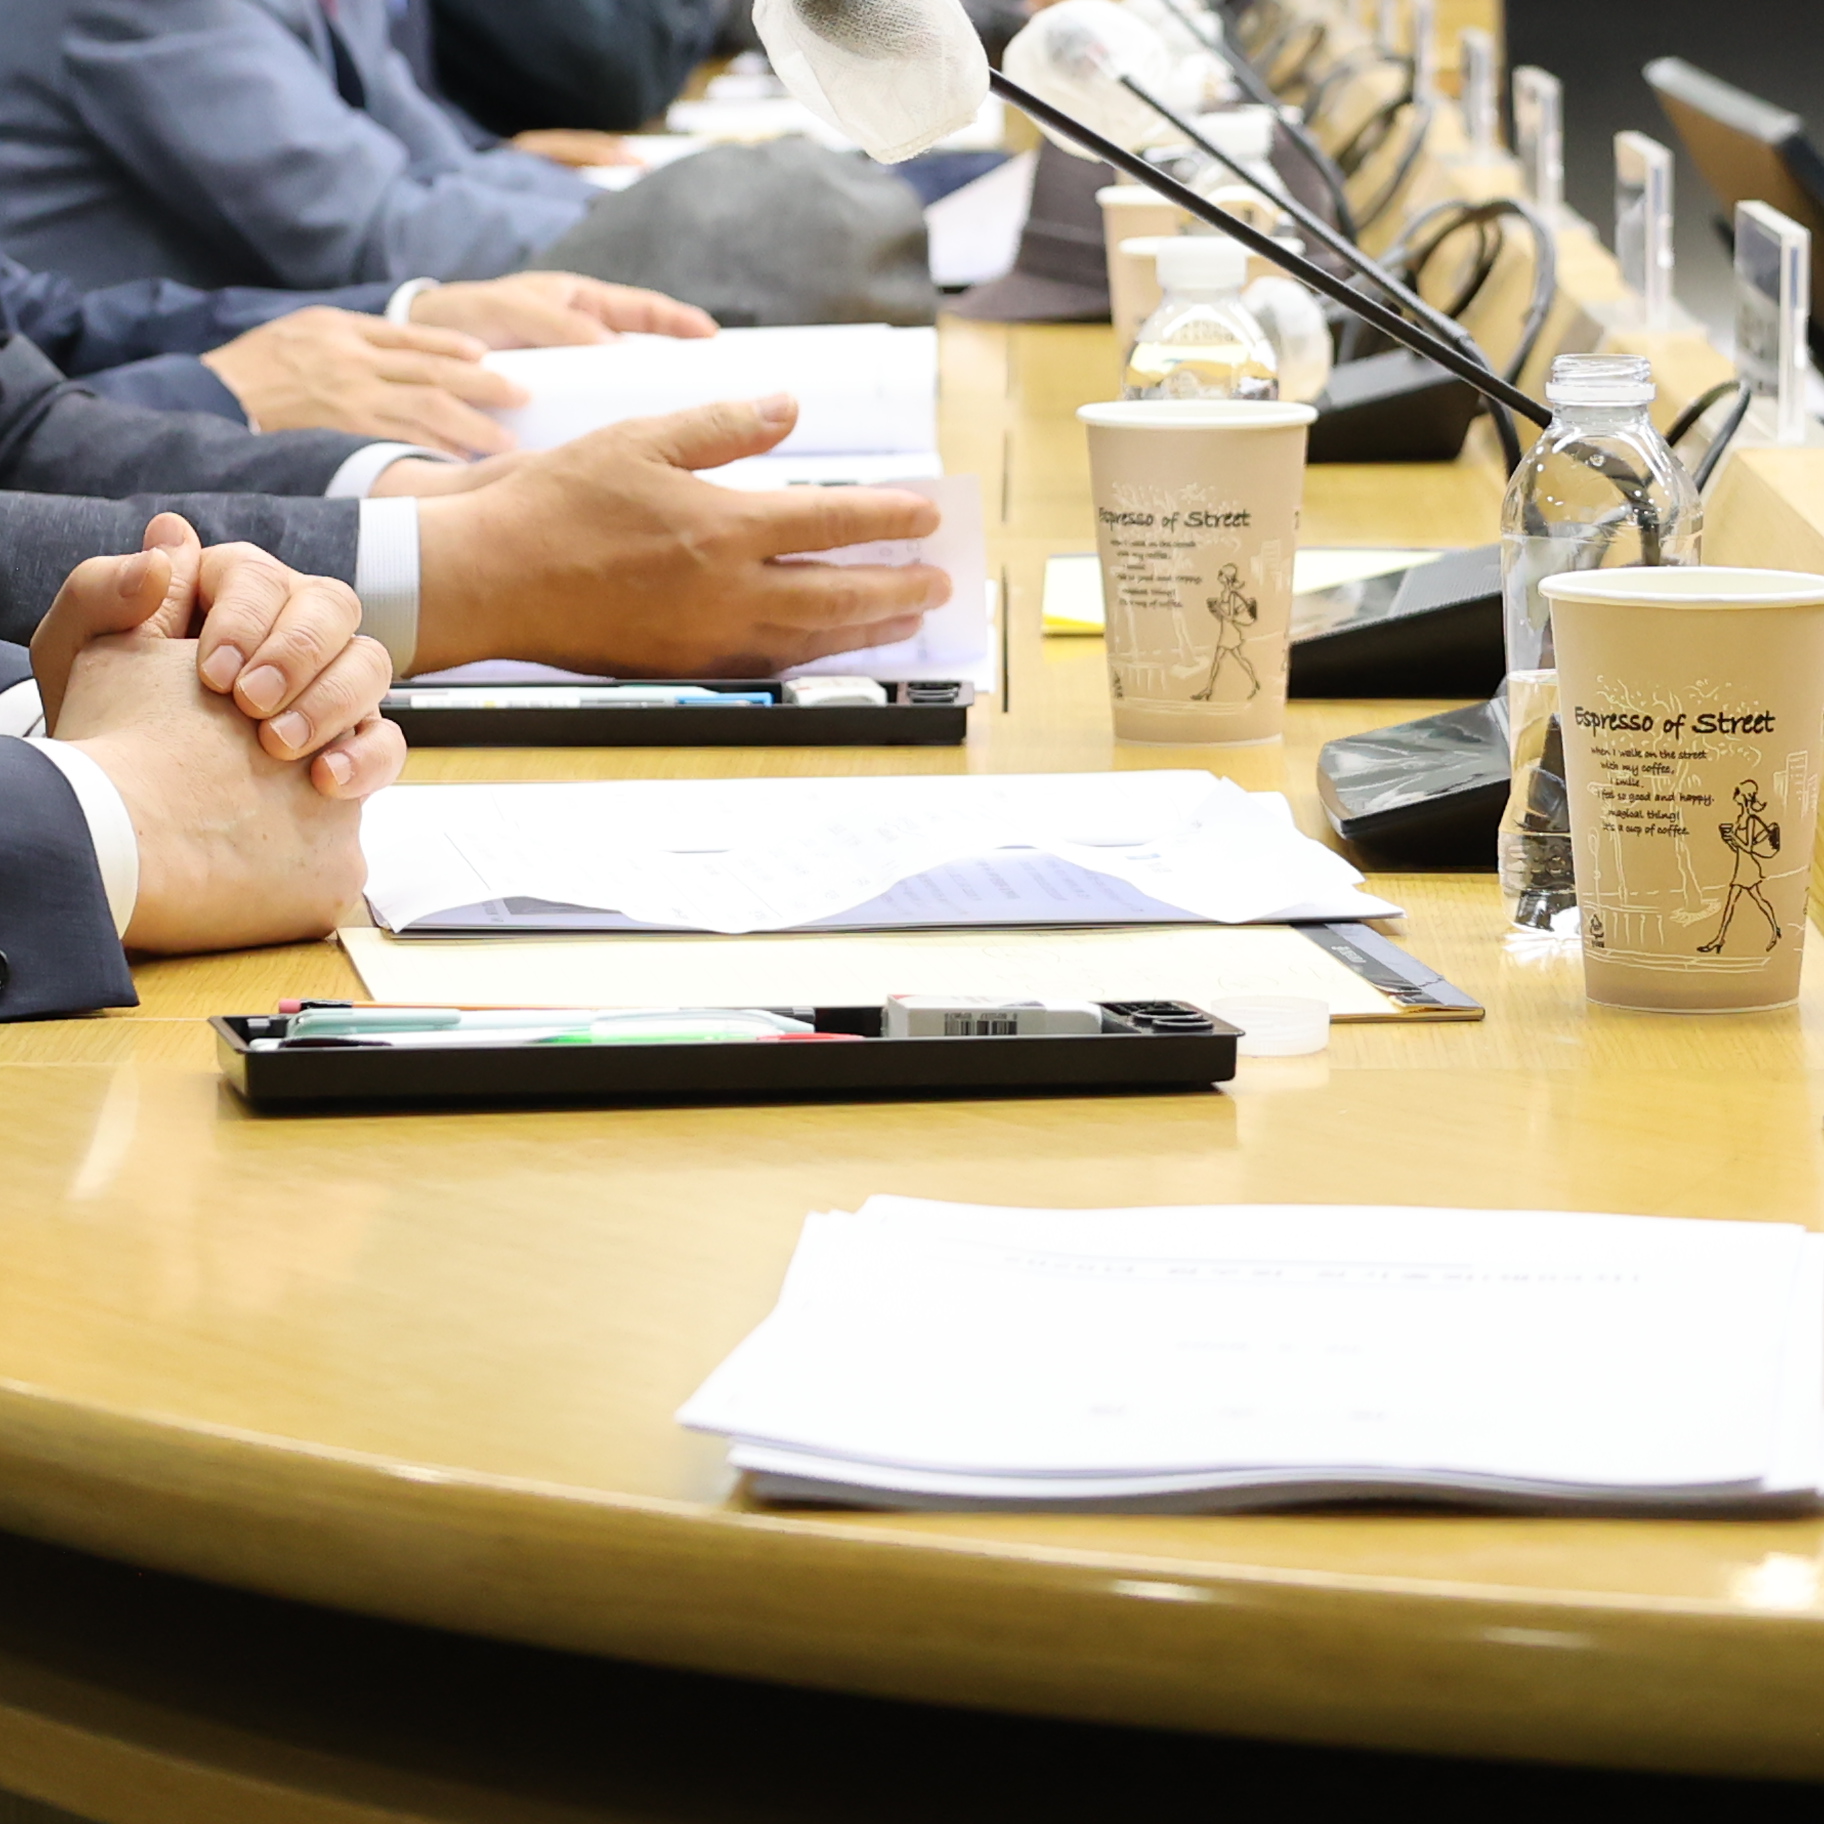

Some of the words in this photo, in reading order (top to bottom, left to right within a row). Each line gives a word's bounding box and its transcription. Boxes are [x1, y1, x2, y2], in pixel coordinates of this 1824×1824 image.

[1162, 511, 1180, 532] of
[1184, 508, 1252, 527] Street
[1575, 706, 1654, 737] Espresso
[1663, 713, 1687, 740] of
[1692, 710, 1776, 735] Street
[1659, 749, 1676, 759] the
[1678, 749, 1707, 760] street
[1622, 764, 1639, 776] my
[1629, 791, 1651, 803] good
[1654, 792, 1675, 801] and
[1644, 823, 1656, 836] of
